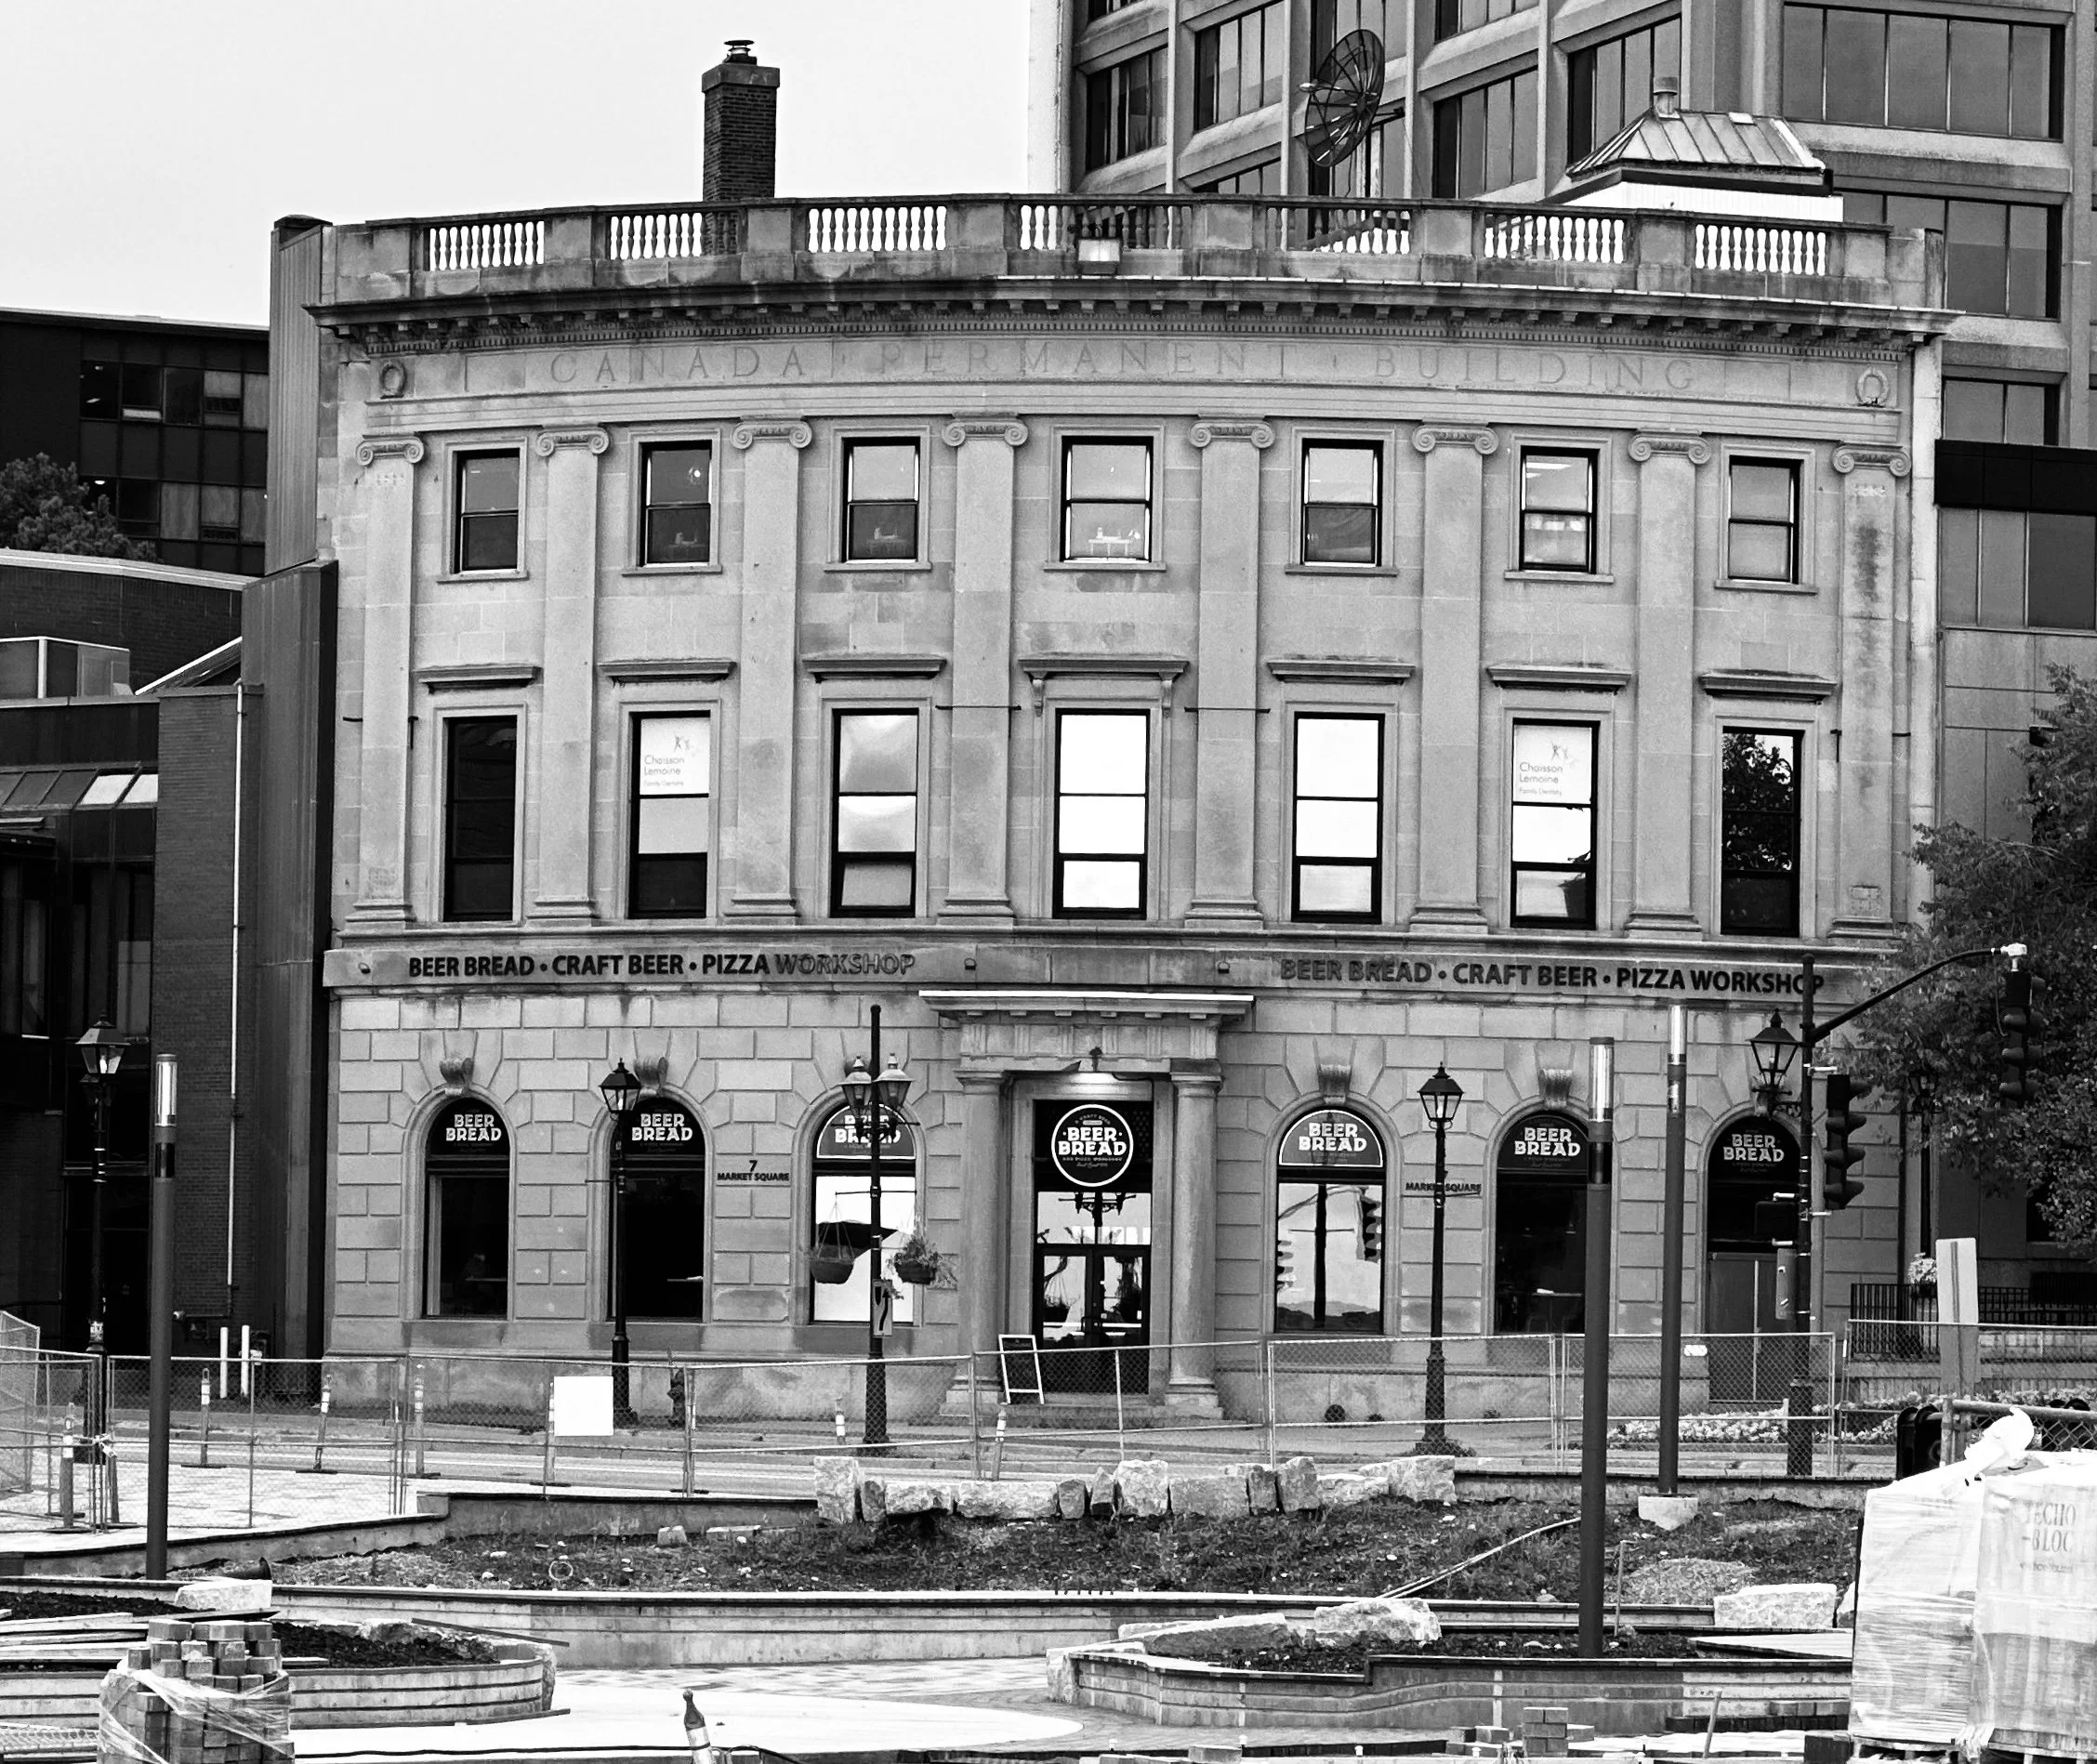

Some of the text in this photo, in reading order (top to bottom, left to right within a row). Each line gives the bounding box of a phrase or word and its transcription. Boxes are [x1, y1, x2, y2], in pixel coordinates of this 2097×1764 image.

[550, 340, 1692, 390] CANADA PERMANENT BUILDING
[409, 954, 916, 977] BEER BREAD CRAFT BEER PIZZA WORKSHOP
[1280, 959, 1825, 994] BEER BREAD CRAFT BEER PIZZA WORKSHOP
[454, 1113, 495, 1127] BEER
[640, 1112, 684, 1127] BEER
[844, 1114, 892, 1129] BR
[445, 1127, 502, 1141] BREAD
[631, 1127, 692, 1141] BREAD
[1067, 1126, 1117, 1141] BEER
[1308, 1122, 1359, 1138] BEER
[1523, 1126, 1573, 1142] BEER
[1058, 1140, 1128, 1155] BREAD
[1298, 1136, 1367, 1152] BREAD
[1731, 1133, 1776, 1148] BEER
[1514, 1140, 1581, 1157] BREAD
[1722, 1146, 1785, 1162] BREAD
[748, 1159, 758, 1172] 7
[717, 1172, 790, 1181] MARKET SQUARE
[1405, 1181, 1482, 1192] MARK SQUARE
